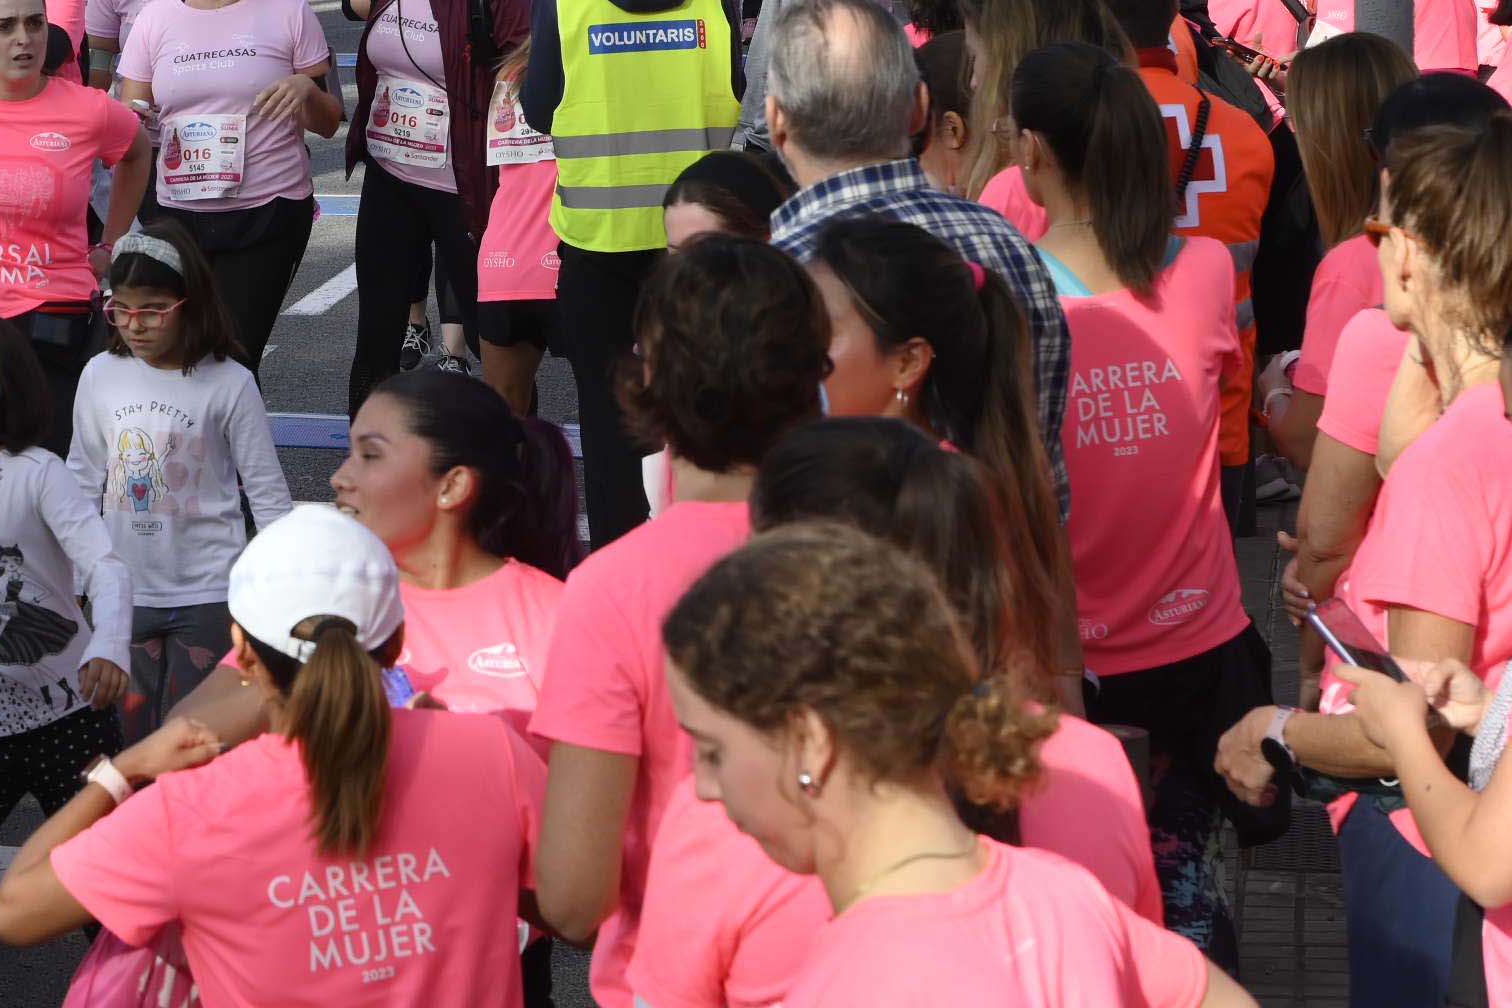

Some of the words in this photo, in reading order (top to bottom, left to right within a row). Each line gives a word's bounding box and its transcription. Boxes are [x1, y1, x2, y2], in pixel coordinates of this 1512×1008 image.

[590, 28, 695, 47] VOLUNTARIS
[173, 48, 257, 64] CUATRECASAS
[391, 112, 417, 128] 016
[183, 148, 212, 161] 016
[483, 257, 515, 269] OYSHO
[115, 404, 143, 421] STAY
[151, 400, 195, 429] PRETTY
[1078, 394, 1113, 422] DE
[1124, 388, 1161, 414] LA
[1076, 413, 1169, 449] MUJER
[1113, 445, 1138, 457] 2023
[268, 848, 450, 909] CARRERA
[308, 899, 359, 937] DE
[373, 889, 423, 927] LA
[309, 922, 435, 972] MUJER
[362, 965, 395, 984] 2023
